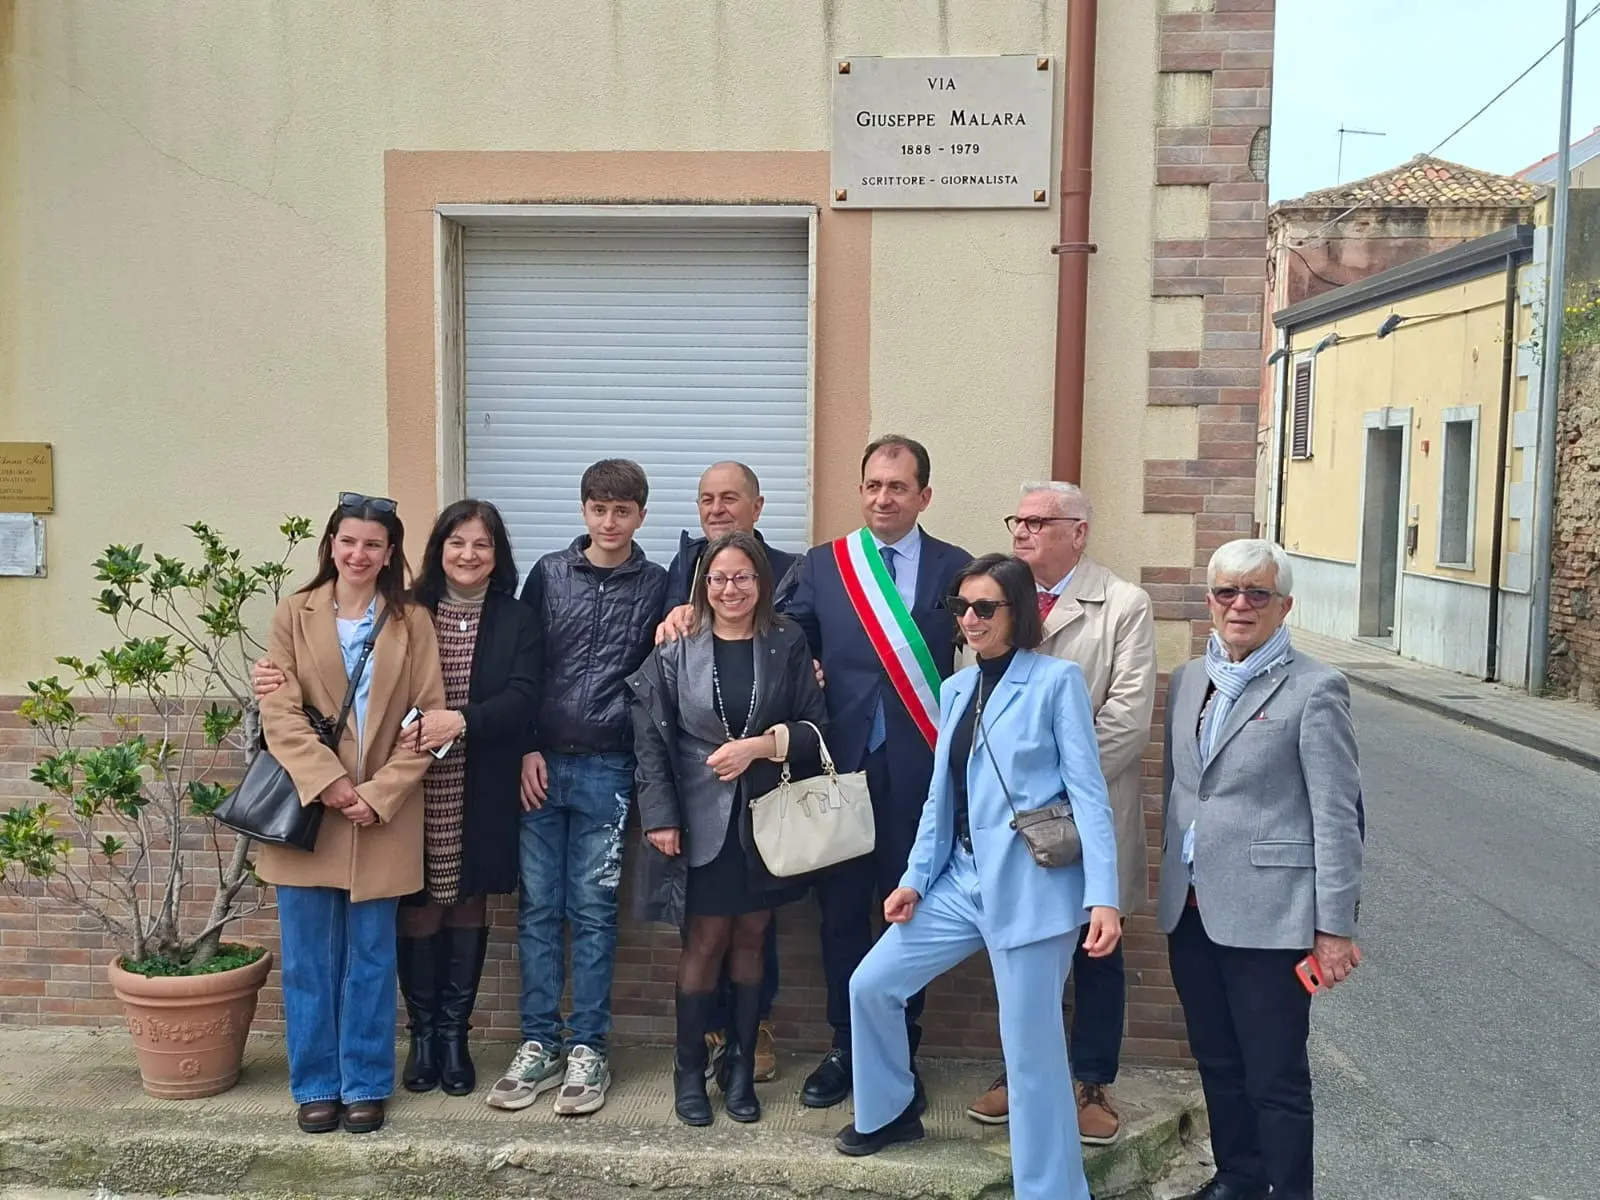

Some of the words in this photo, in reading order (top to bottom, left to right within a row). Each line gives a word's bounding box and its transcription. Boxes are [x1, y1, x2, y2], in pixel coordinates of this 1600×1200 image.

[927, 77, 957, 91] VIA
[901, 144, 932, 155] 1888
[950, 143, 980, 155] 1979
[861, 176, 926, 186] SCRITTORE
[940, 175, 1018, 185] GIORNALISTA
